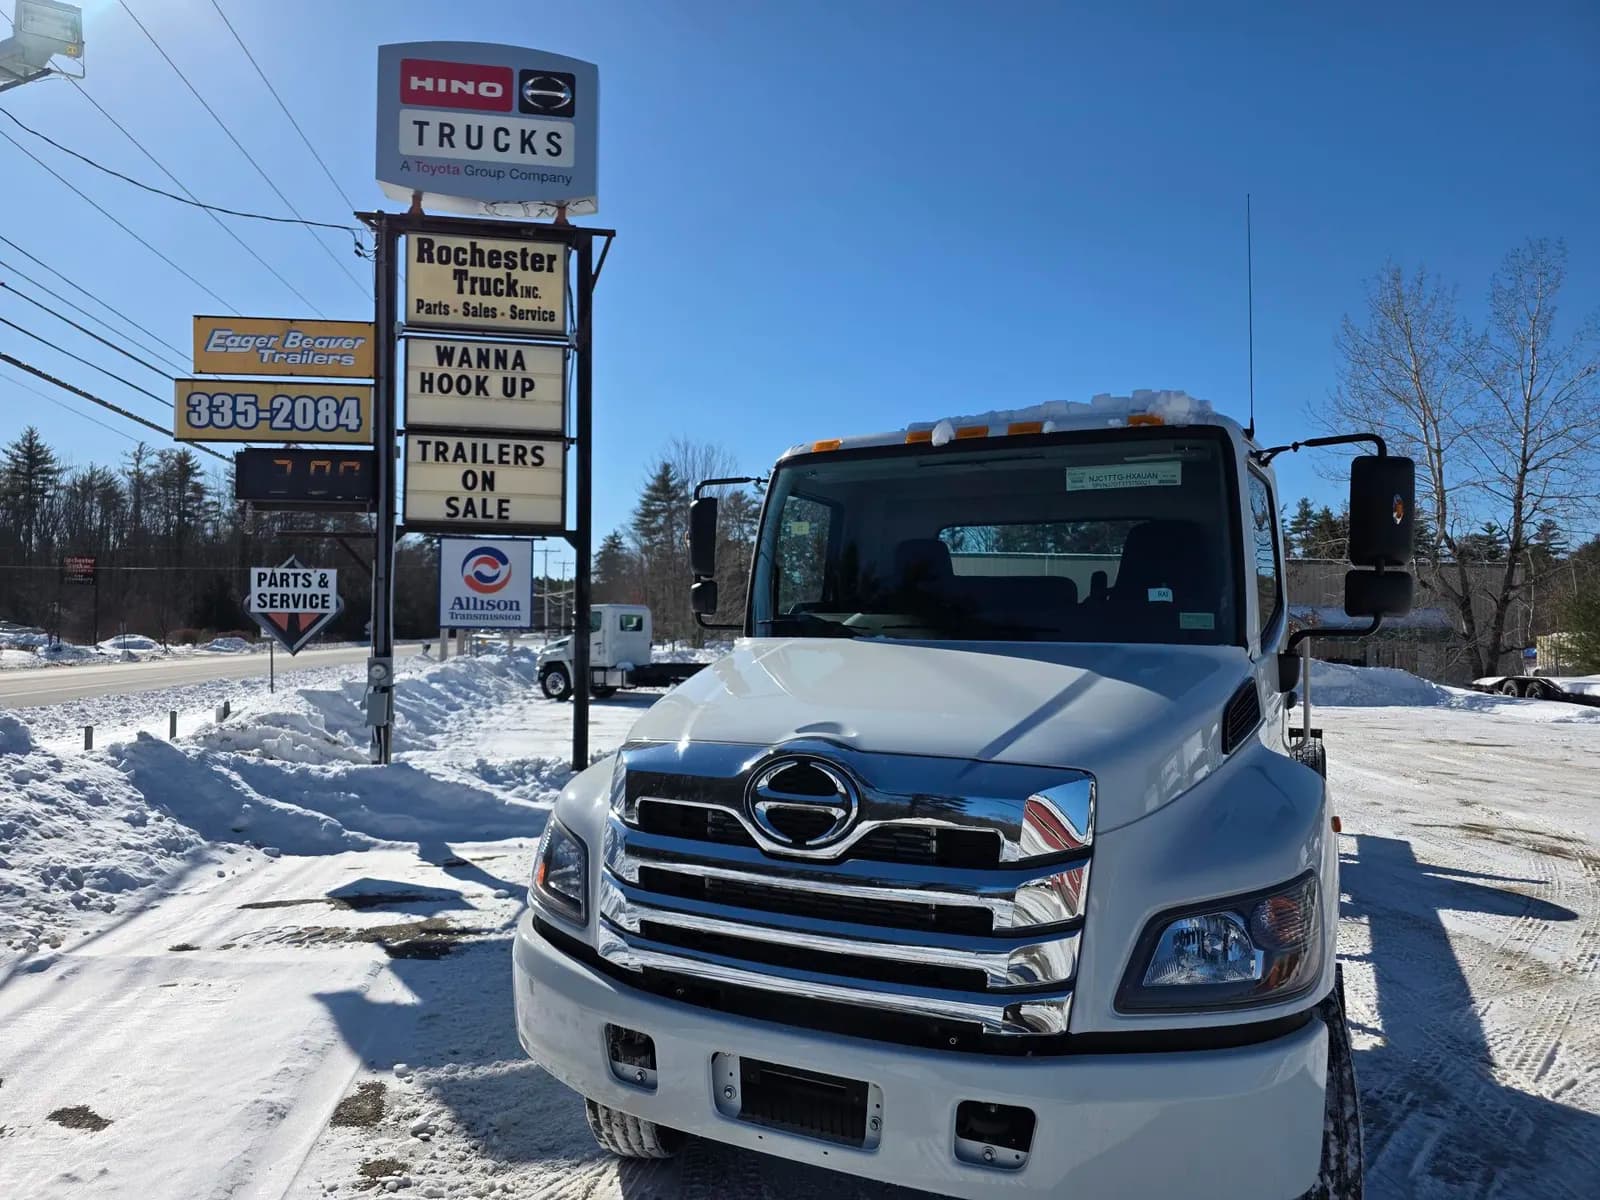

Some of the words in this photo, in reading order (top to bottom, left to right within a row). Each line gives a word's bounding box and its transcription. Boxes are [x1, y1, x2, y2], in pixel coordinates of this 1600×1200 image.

[410, 76, 503, 98] HINO
[413, 120, 562, 157] TRUCKS
[400, 161, 410, 172] A
[415, 161, 460, 176] Toyota
[464, 165, 505, 179] Group
[509, 168, 572, 186] Company
[416, 237, 557, 273] Rochester
[453, 269, 519, 298] Truck
[520, 285, 542, 300] INC.
[416, 299, 450, 316] Parts
[462, 302, 497, 319] Sales
[510, 305, 555, 322] Service
[206, 328, 278, 353] Eager
[283, 330, 365, 351] Beaver
[259, 349, 356, 366] Trailers
[435, 345, 526, 371] WANNA
[420, 371, 490, 397] HOOK
[502, 376, 535, 398] UP
[186, 392, 362, 433] 335-2084
[417, 440, 545, 467] TRAILERS
[461, 469, 495, 492] ON
[445, 496, 511, 520] SALE
[257, 572, 312, 588] PARTS
[318, 572, 329, 588] &
[257, 593, 330, 609] SERVICE
[449, 596, 520, 611] Allison
[448, 611, 521, 621] Transmission
